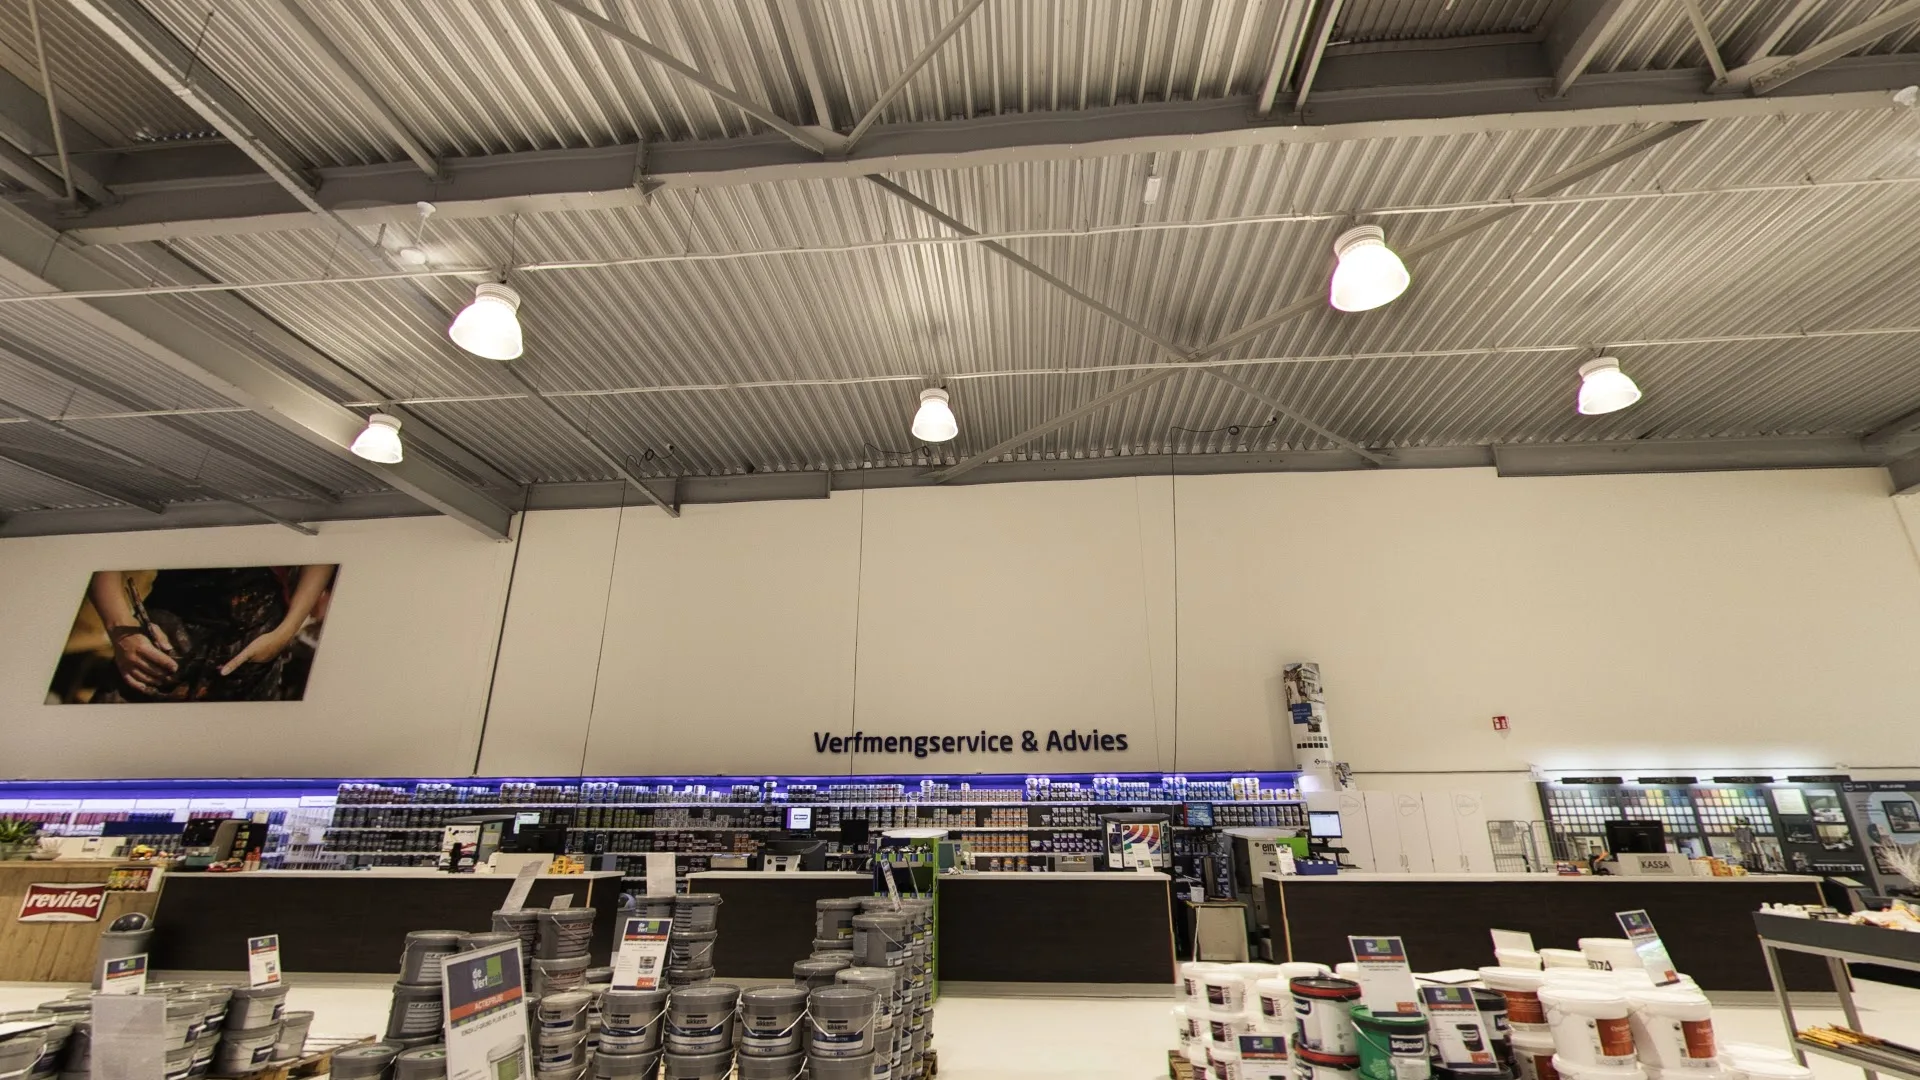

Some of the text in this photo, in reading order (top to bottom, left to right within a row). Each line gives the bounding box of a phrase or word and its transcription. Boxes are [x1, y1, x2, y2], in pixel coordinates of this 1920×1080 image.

[814, 729, 1128, 757] Verfmengservice & Advies
[1641, 860, 1670, 869] KASSA
[26, 891, 102, 908] revilac
